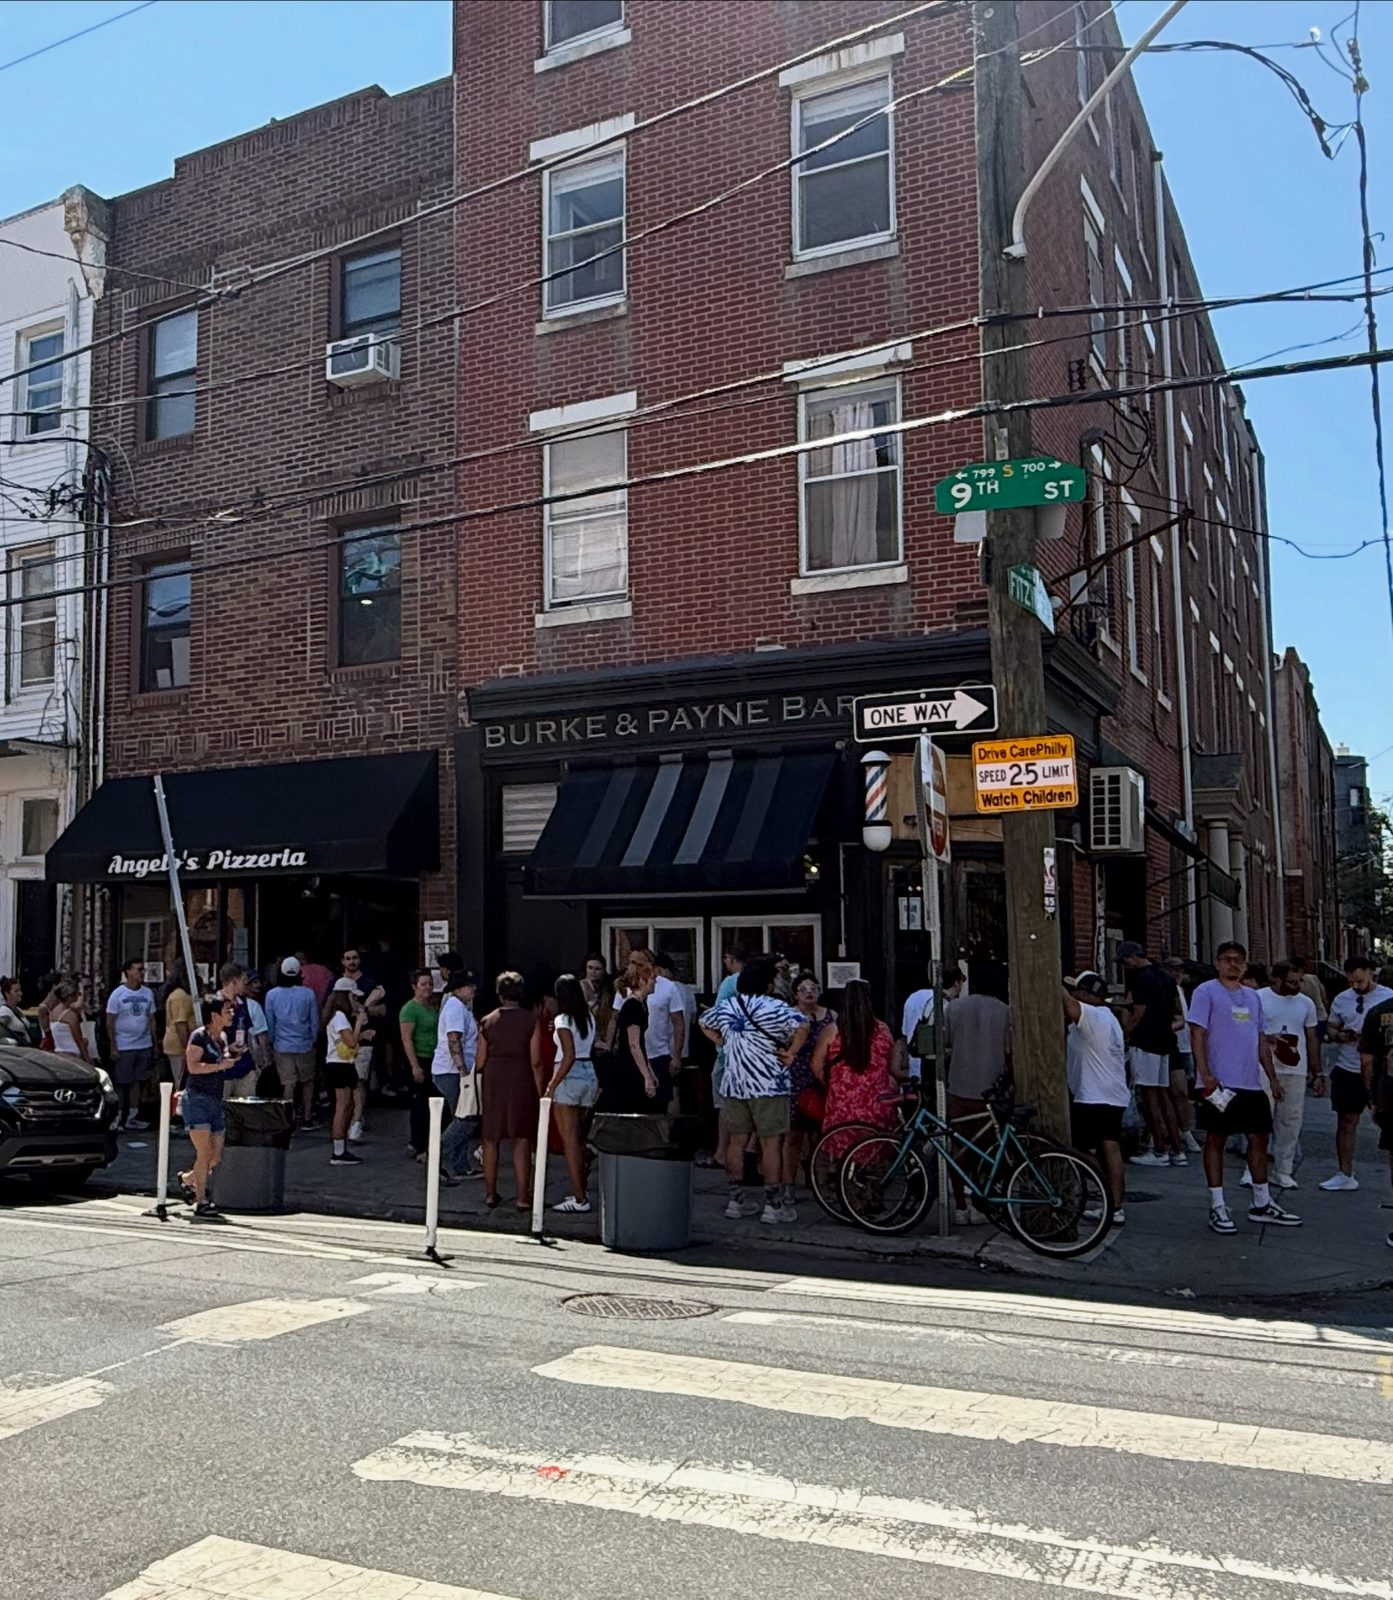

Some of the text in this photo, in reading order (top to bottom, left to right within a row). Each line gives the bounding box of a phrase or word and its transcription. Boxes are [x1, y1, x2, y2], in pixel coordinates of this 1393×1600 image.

[972, 462, 1046, 479] 799 S 700
[951, 480, 1075, 509] 9TH ST
[485, 696, 854, 748] BURKE & PAYNE BAR
[870, 702, 953, 726] ONE WAY
[978, 742, 1067, 761] Drive CarePhilly
[979, 762, 1070, 786] SPEED 25 LIMIT
[981, 789, 1073, 808] Watch Children
[206, 848, 308, 870] Pizzeria
